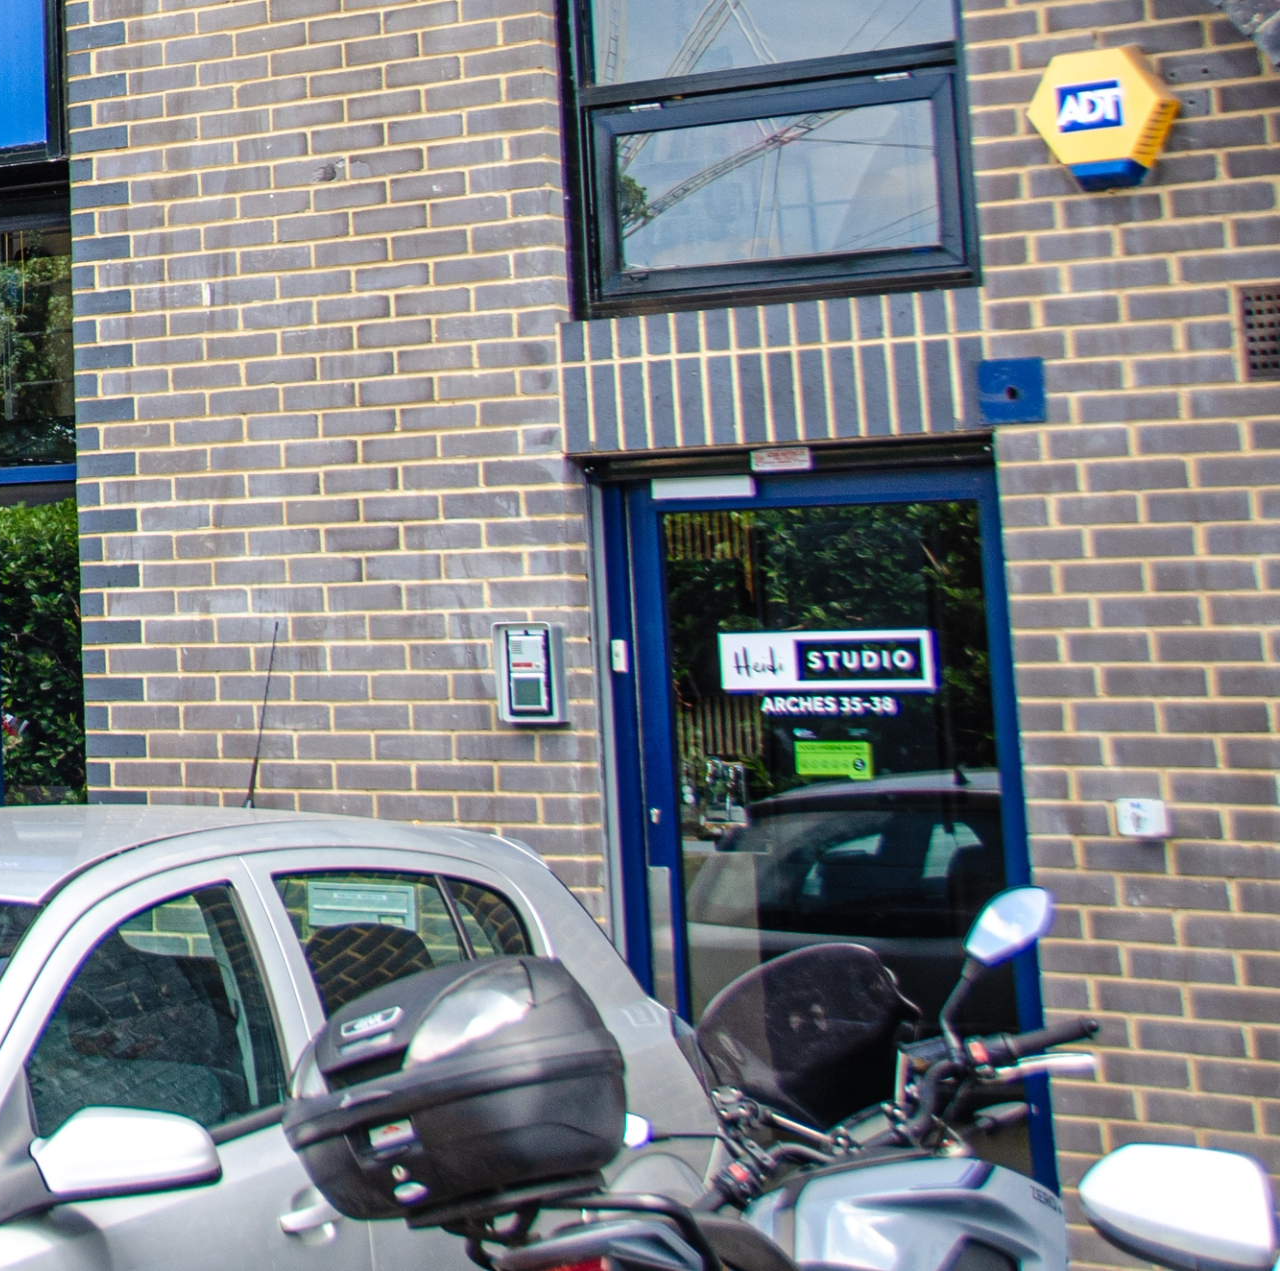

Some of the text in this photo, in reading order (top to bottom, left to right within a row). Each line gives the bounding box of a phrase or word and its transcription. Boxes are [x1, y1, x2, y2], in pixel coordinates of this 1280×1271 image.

[1057, 88, 1123, 125] ADT
[733, 646, 915, 677] Heidi STUDIO
[760, 695, 897, 714] ARCHES 35-38
